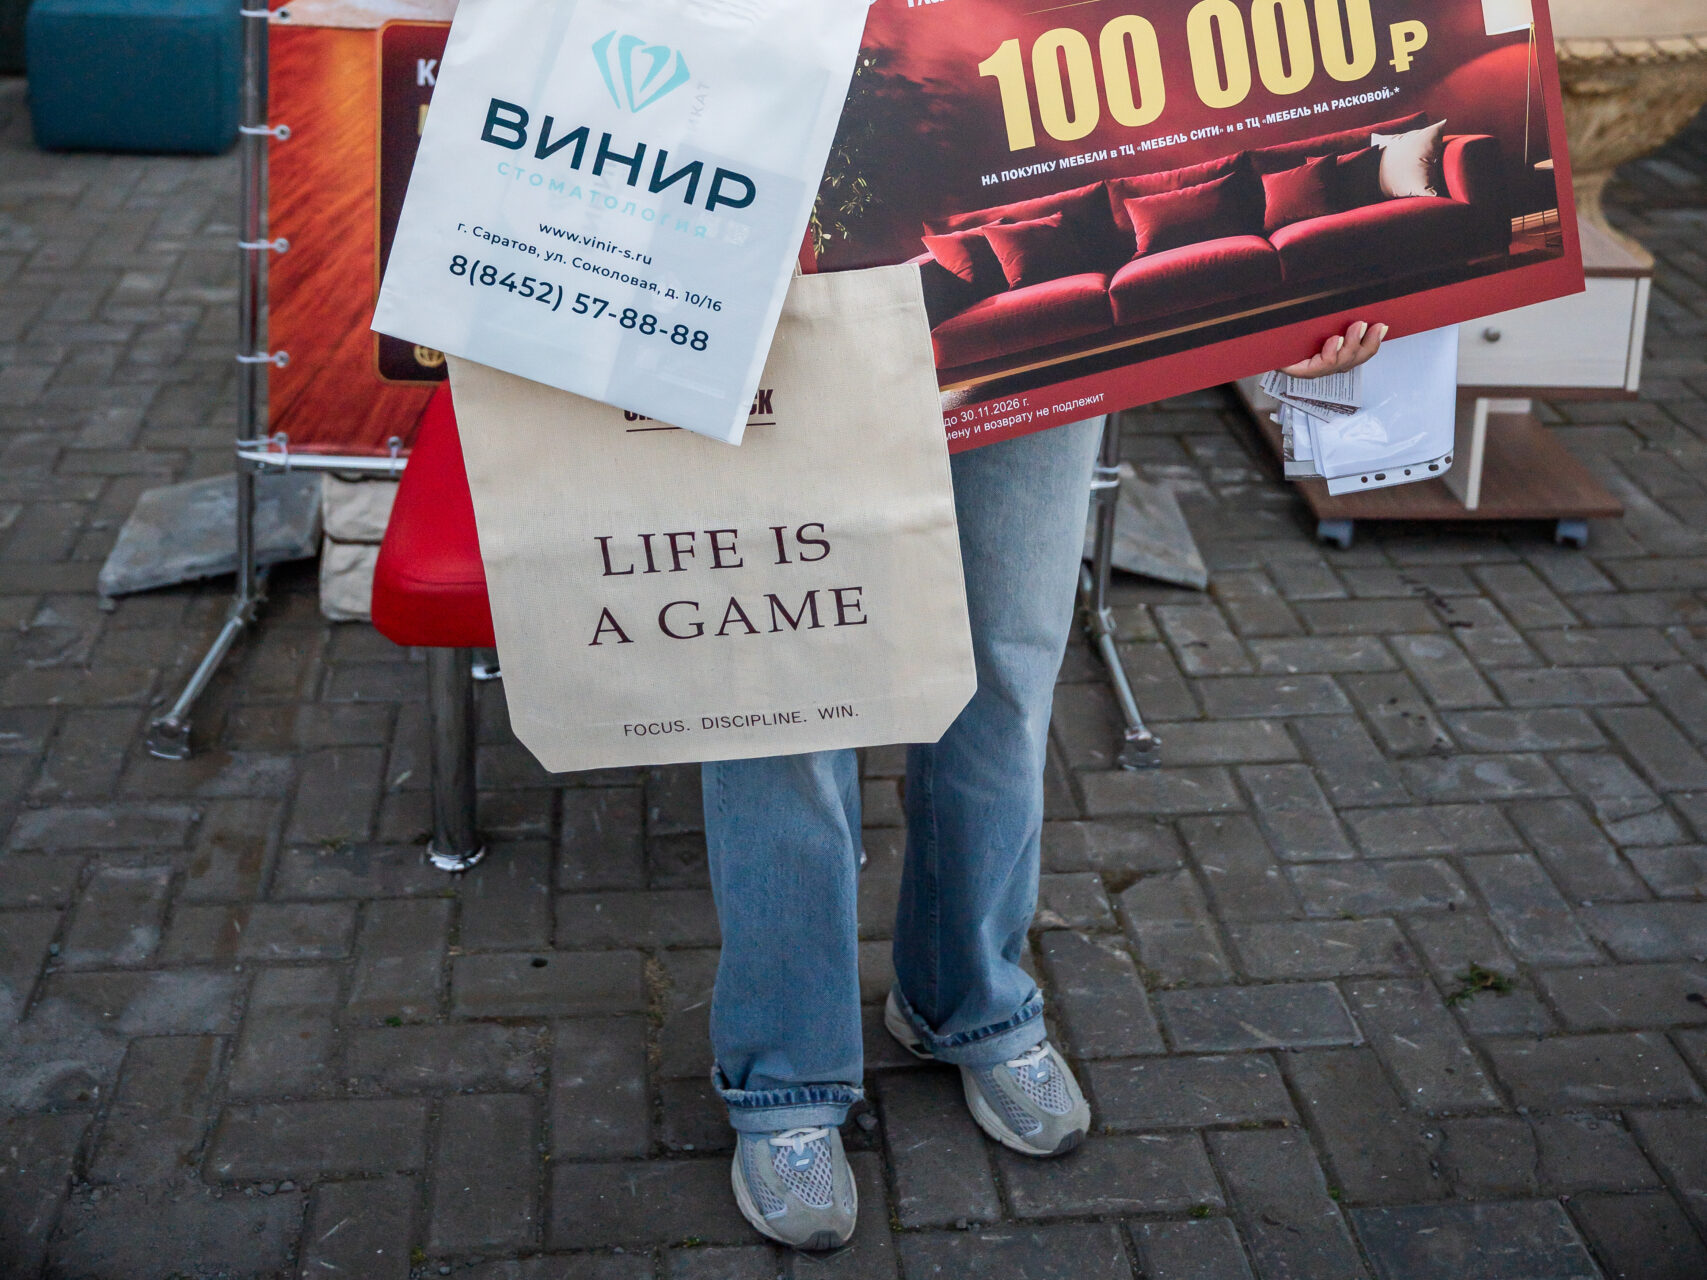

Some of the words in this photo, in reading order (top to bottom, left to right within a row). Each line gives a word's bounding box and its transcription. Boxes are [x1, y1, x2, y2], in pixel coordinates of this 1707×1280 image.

[977, 14, 1166, 152] 100
[480, 97, 757, 212] ВИНИР
[981, 174, 999, 186] НА
[1001, 161, 1057, 182] ПОКУПКУ
[1059, 150, 1108, 170] МЕБЕЛИ
[1110, 150, 1118, 158] в
[1119, 143, 1135, 156] ТЦ
[1136, 132, 1188, 152] «МЕБЕЛЬ
[1226, 124, 1234, 133] и
[1237, 122, 1244, 131] в
[1245, 117, 1260, 129] ТЦ
[1262, 106, 1311, 125] «МЕБЕЛЬ
[1313, 102, 1329, 115] НА
[496, 161, 709, 239] СТОМАТОЛОГИЯ
[457, 222, 468, 234] г.
[473, 226, 541, 258] Саратов,
[545, 250, 567, 265] ул.
[572, 257, 661, 295] Соколовая,
[664, 288, 679, 301] д.
[684, 291, 723, 312] 10/16
[539, 222, 653, 265] www.vinir-s.ru
[449, 254, 563, 312] 8(8452)
[571, 292, 710, 352] 57-88-88
[944, 416, 958, 427] до
[960, 398, 1021, 423] 30.11.2026
[1022, 397, 1030, 407] г.
[974, 424, 981, 434] и
[984, 412, 1034, 431] возврату
[1036, 407, 1050, 418] не
[1052, 392, 1105, 414] подлежит
[594, 529, 744, 576] LIFE
[769, 522, 831, 565] IS
[588, 606, 634, 646] A
[658, 586, 867, 640] GAME
[624, 719, 690, 737] FOCUS.
[701, 711, 807, 730] DISCIPLINE.
[817, 704, 859, 721] WIN.
